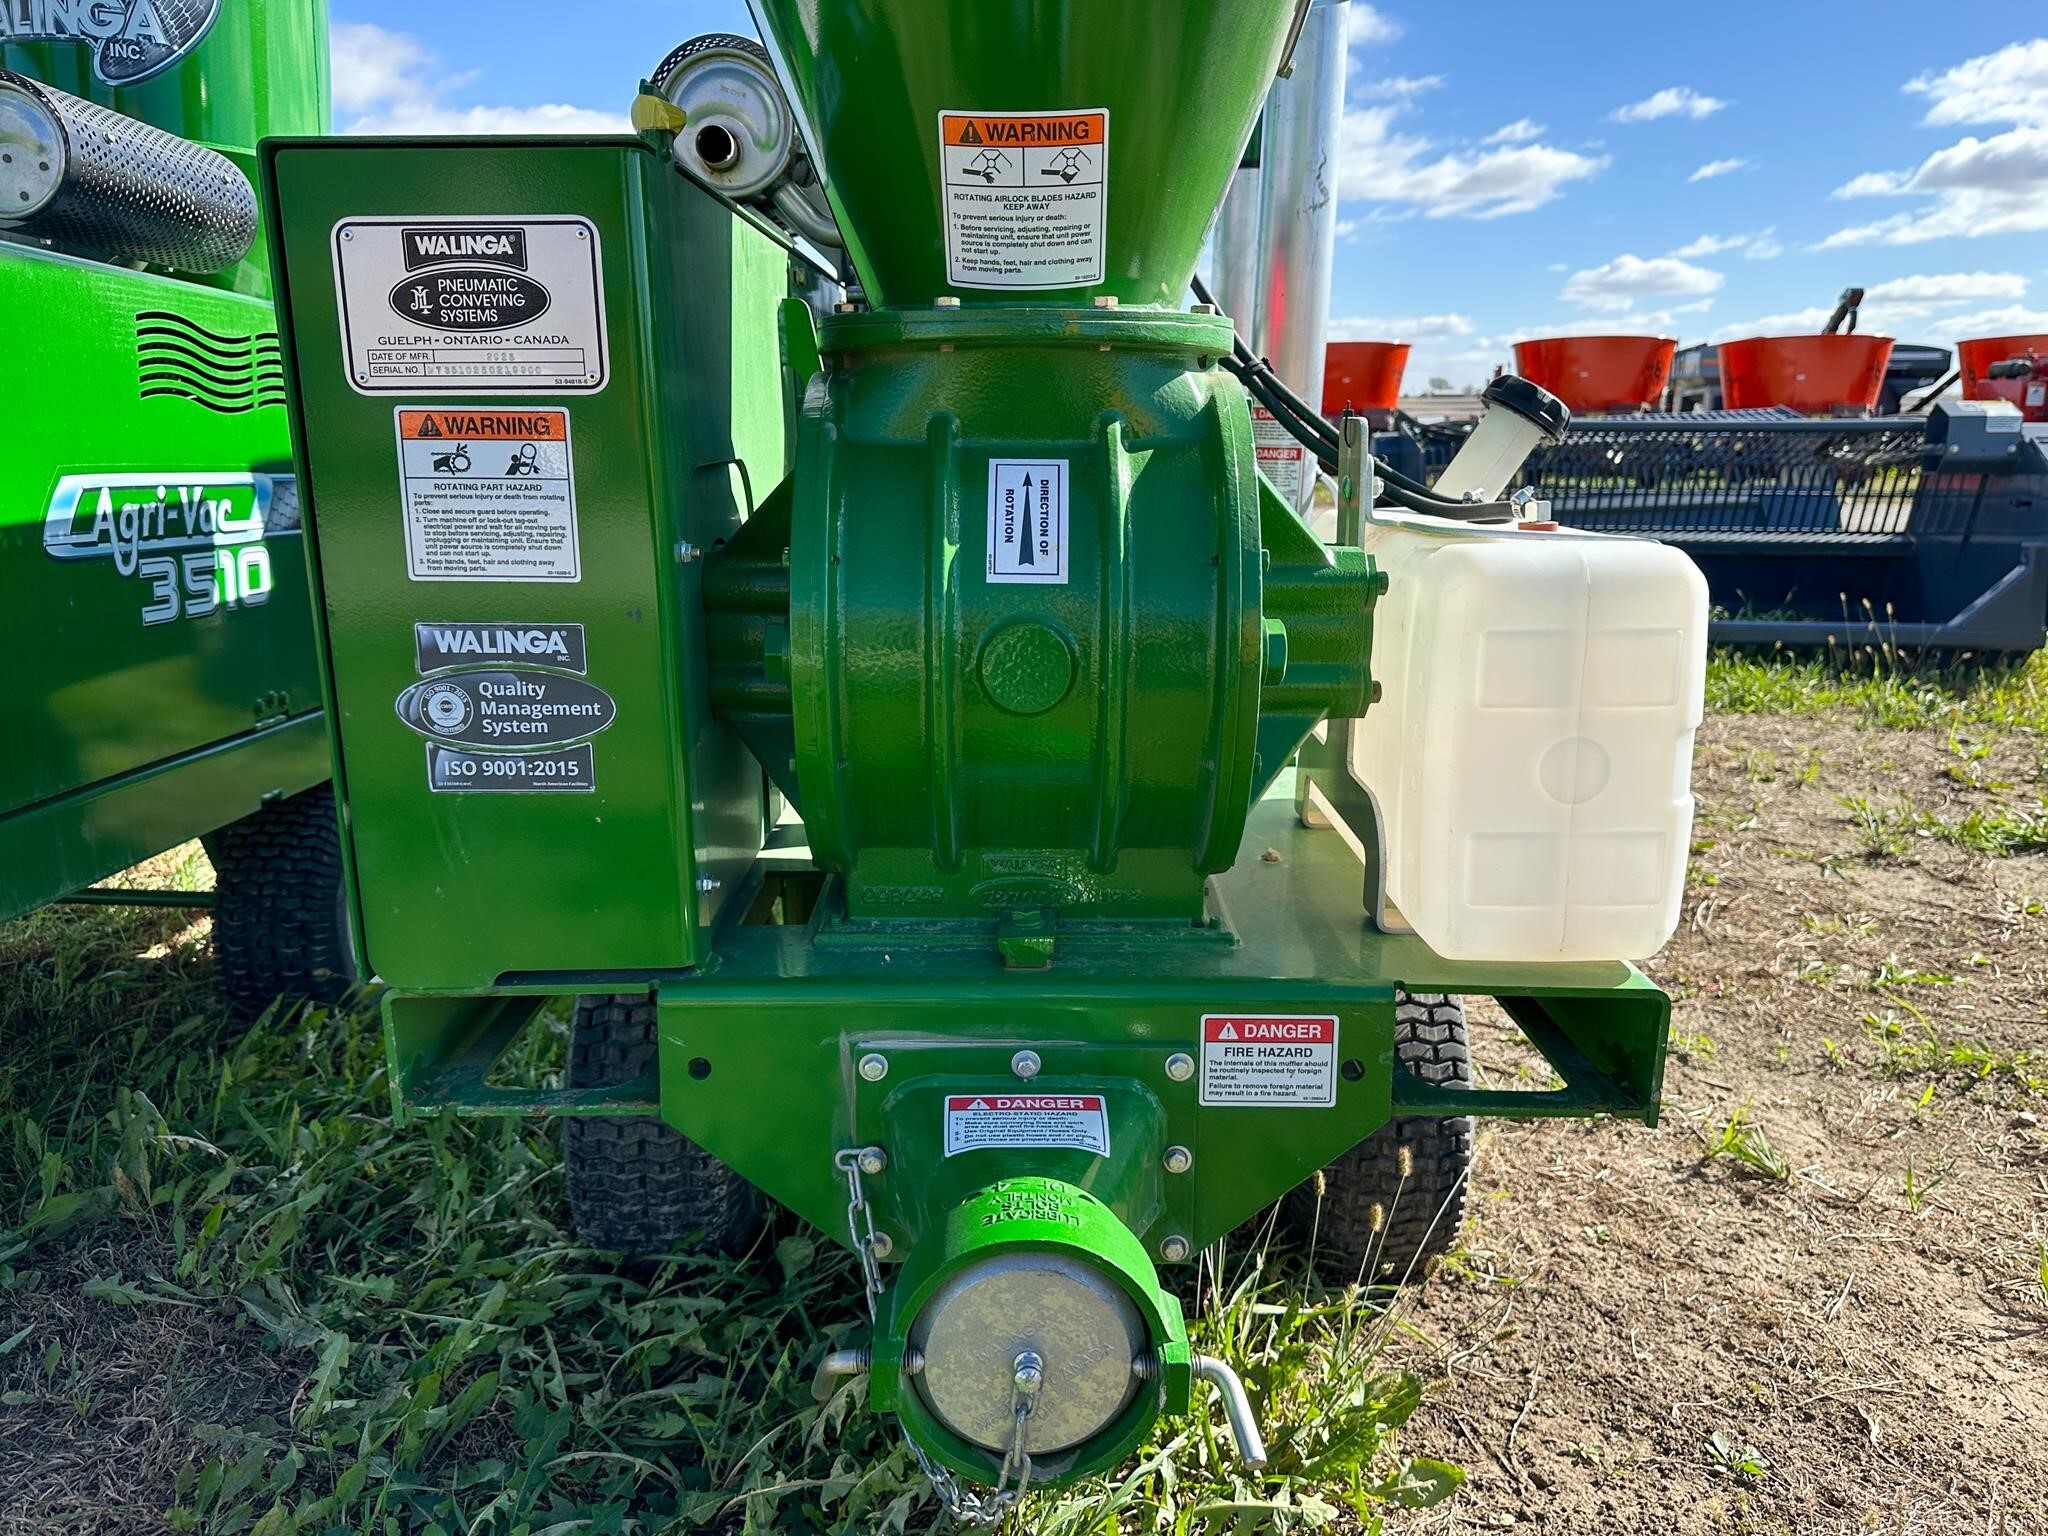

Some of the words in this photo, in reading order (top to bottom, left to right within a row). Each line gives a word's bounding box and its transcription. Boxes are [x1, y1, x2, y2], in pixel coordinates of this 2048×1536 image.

[109, 43, 146, 60] INC.
[985, 121, 1089, 142] WARNING
[954, 193, 992, 202] ROTATING
[1031, 194, 1063, 202] BLADES
[1065, 192, 1096, 200] HAZARD
[983, 226, 1016, 234] servicing,
[1017, 226, 1051, 234] adjusting,
[1052, 224, 1082, 232] repairing
[961, 232, 999, 241] maintaining
[1000, 233, 1015, 241] unit,
[1071, 231, 1091, 239] power
[992, 241, 1028, 249] completely
[962, 257, 978, 266] Keep
[980, 258, 1001, 266] hands,
[978, 266, 1002, 274] moving
[438, 278, 518, 292] PNEUMATIC
[439, 294, 525, 307] CONVEYING
[440, 310, 498, 322] SYSTEMS
[378, 336, 432, 345] GUELPH
[443, 335, 502, 345] ONTARIO
[514, 335, 569, 345] CANADA
[444, 416, 550, 435] WARNING
[1257, 449, 1297, 459] DANGER
[434, 483, 478, 491] ROTATING
[1040, 480, 1049, 536] DIRECTION
[1005, 489, 1014, 543] ROTATION
[93, 485, 232, 576] Agri-Vac
[1040, 540, 1048, 556] OF
[138, 545, 271, 627] 3510
[425, 690, 434, 700] ISO
[479, 681, 545, 700] Quality
[481, 701, 601, 719] Management
[482, 719, 548, 736] System
[445, 761, 476, 776] ISO
[483, 761, 579, 776] 9001:2015
[1245, 1024, 1321, 1038] DANGER
[1225, 1047, 1254, 1057] FIRE
[1258, 1047, 1313, 1057] HAZARD
[1219, 1067, 1249, 1075] routinely
[1251, 1067, 1285, 1075] inspected
[1269, 1083, 1294, 1091] foreign
[997, 1100, 1084, 1108] DANGER
[1001, 1202, 1060, 1212] BOLTS
[981, 1210, 1080, 1227] LUBRICATE
